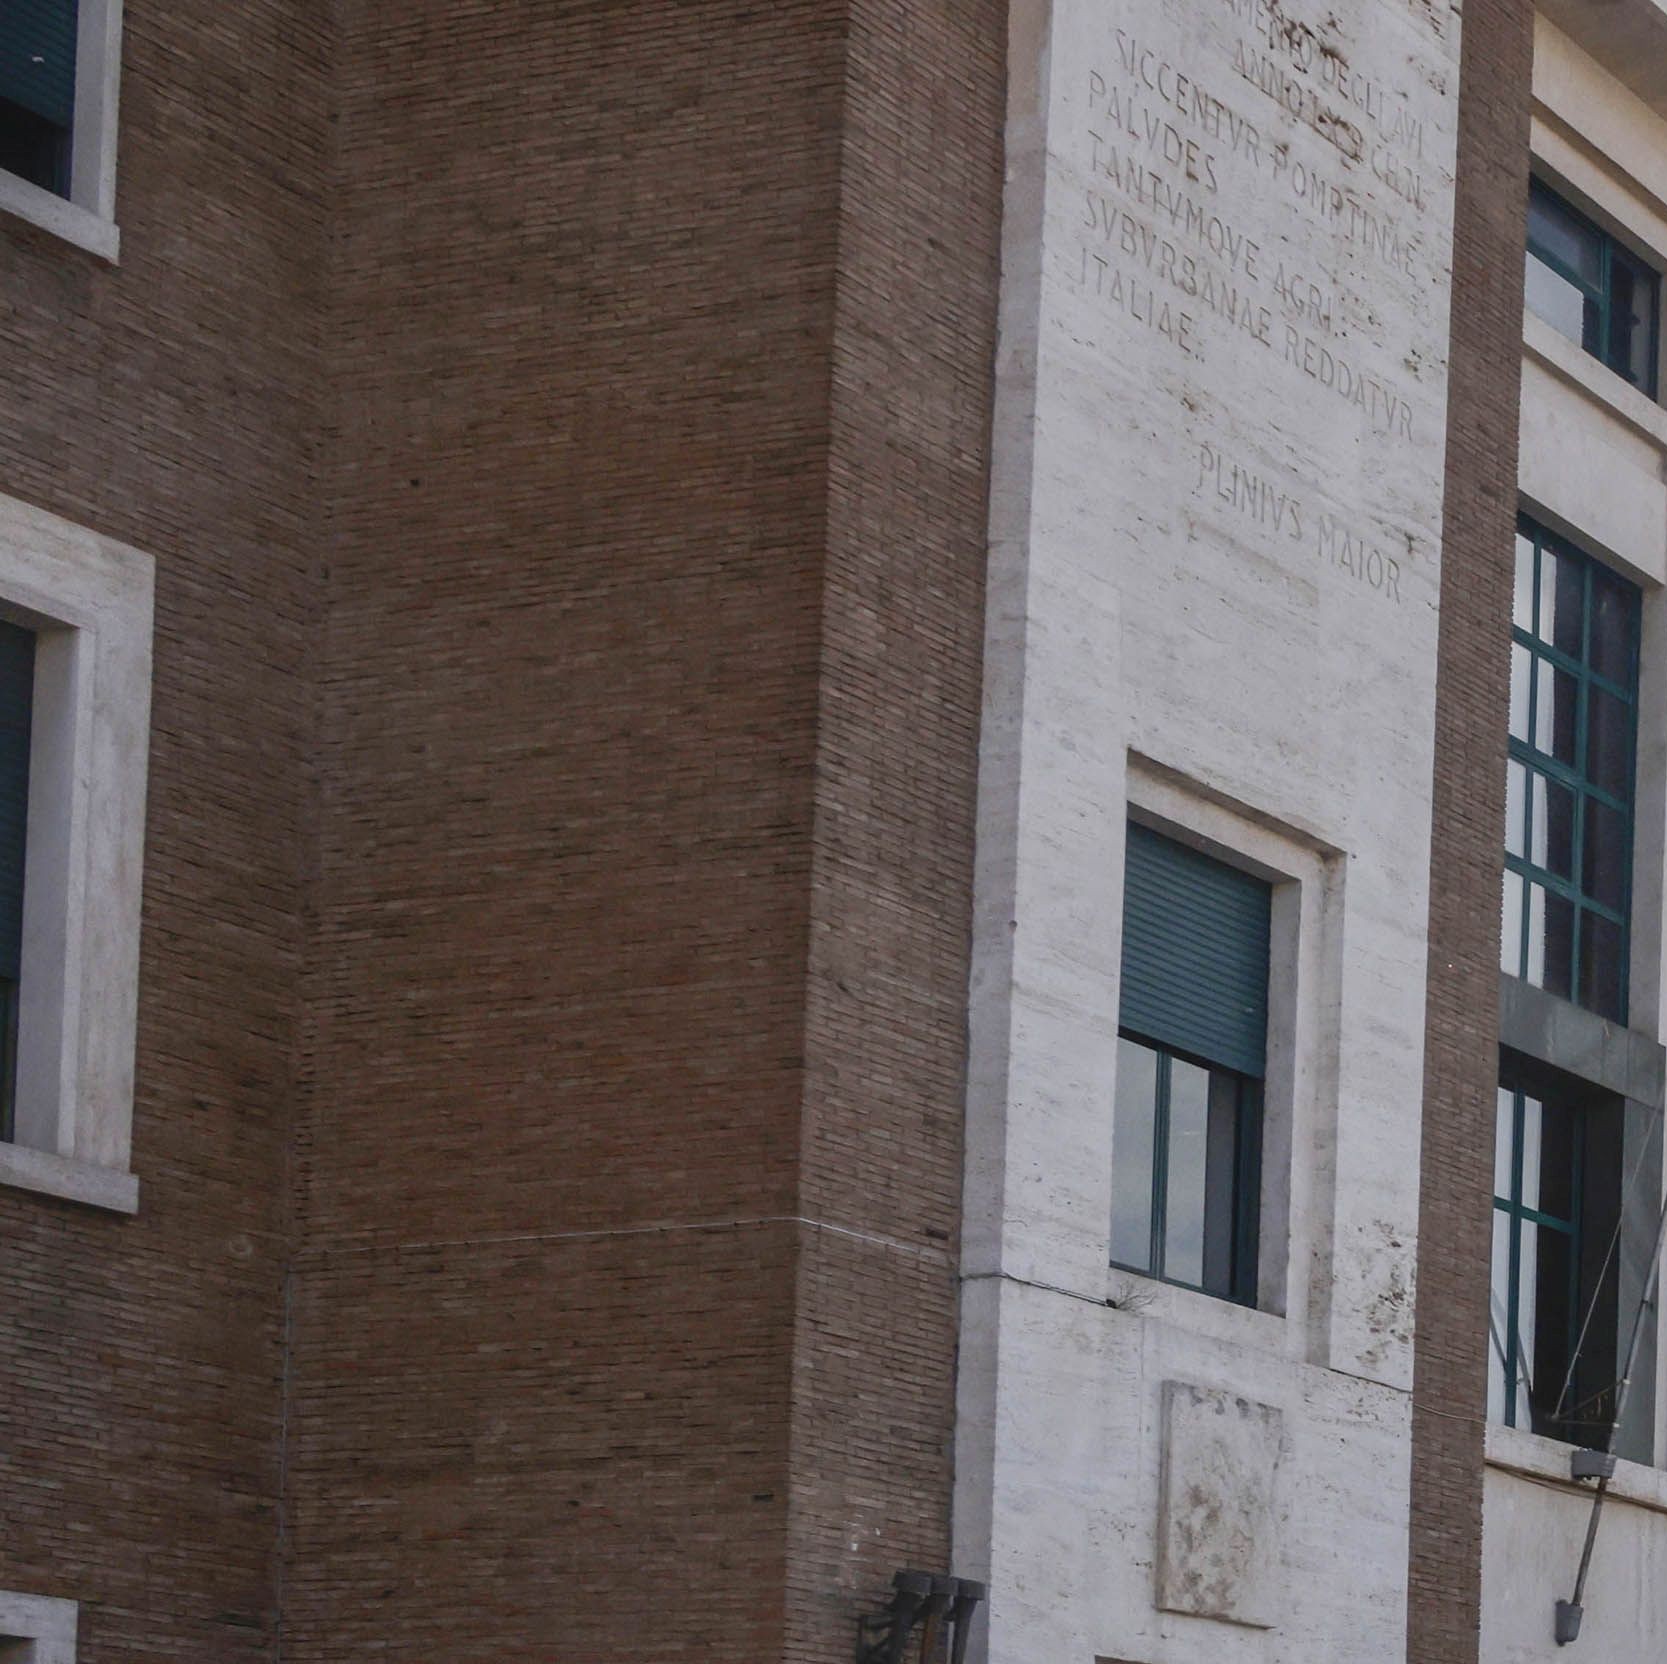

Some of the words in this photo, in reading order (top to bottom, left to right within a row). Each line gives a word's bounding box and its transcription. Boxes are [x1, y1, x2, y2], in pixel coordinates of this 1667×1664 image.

[1088, 69, 1220, 196] PALVDES
[1083, 190, 1272, 348] SVBVRBANAE
[1284, 323, 1414, 442] REDDATVR
[1199, 444, 1302, 541] PLINIVS
[1316, 512, 1402, 604] MAIOR
